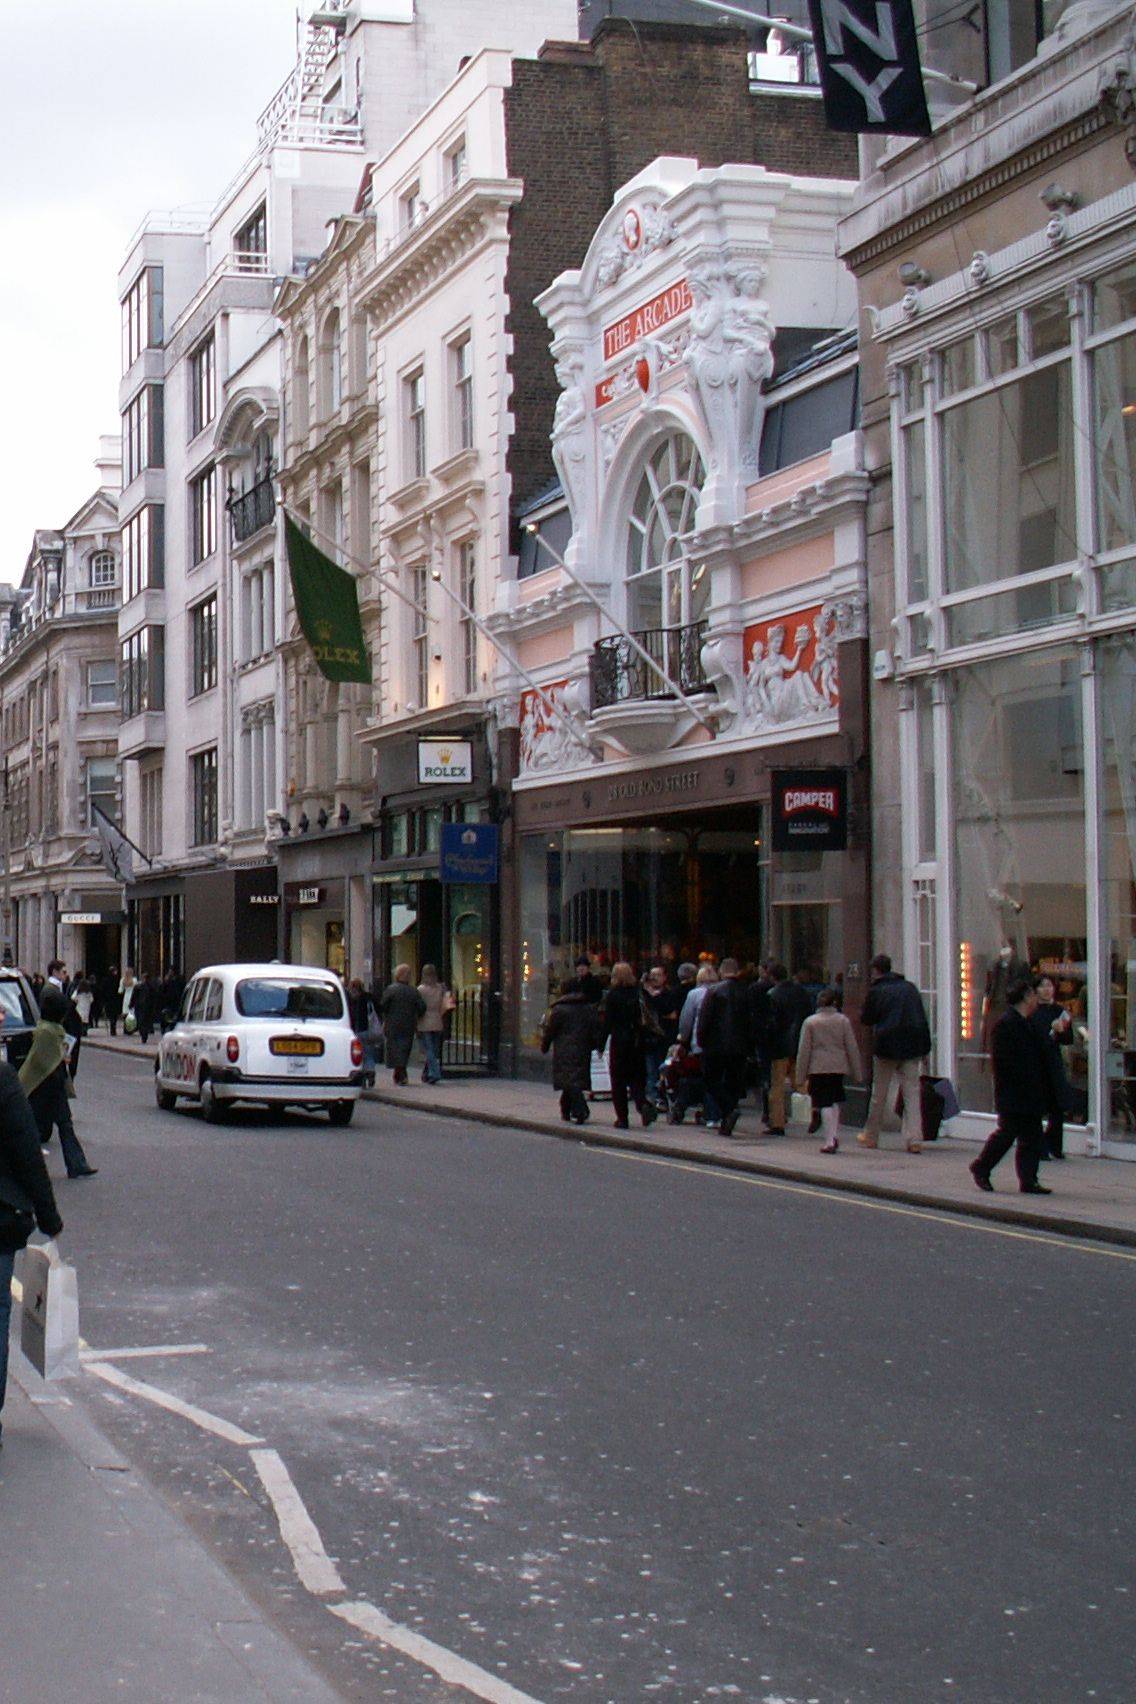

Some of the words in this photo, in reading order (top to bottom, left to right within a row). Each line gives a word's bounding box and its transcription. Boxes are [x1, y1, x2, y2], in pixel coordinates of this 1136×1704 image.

[605, 319, 631, 356] THE
[634, 281, 692, 339] ARCADE
[312, 645, 360, 665] OLEX
[424, 766, 466, 777] ROLEX
[638, 779, 662, 797] BOND
[665, 771, 701, 794] STREET
[784, 791, 834, 812] CAMPER
[249, 895, 279, 904] BALLY
